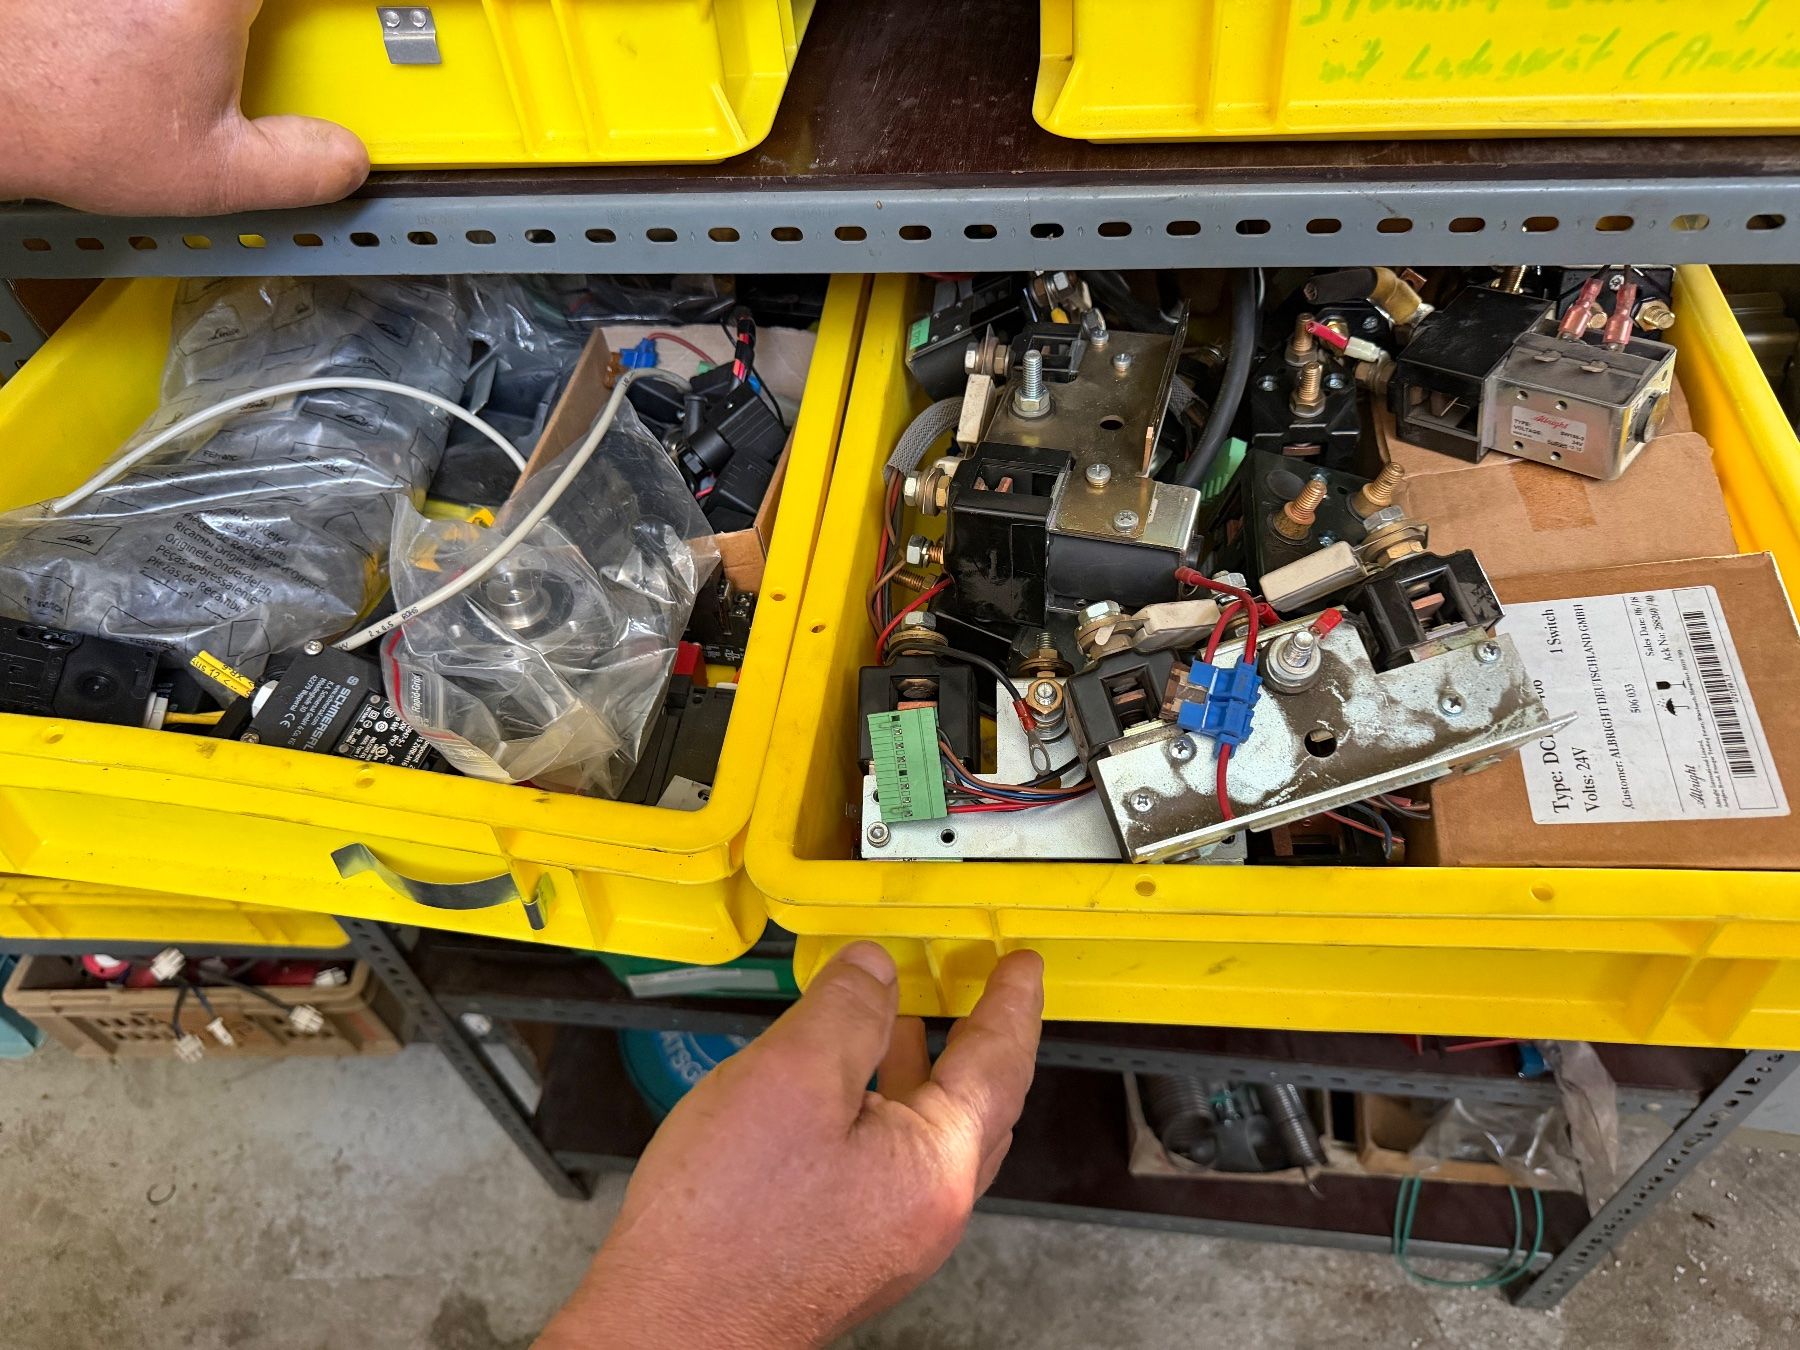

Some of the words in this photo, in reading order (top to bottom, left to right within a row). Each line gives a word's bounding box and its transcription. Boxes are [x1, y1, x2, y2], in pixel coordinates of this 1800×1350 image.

[1541, 608, 1562, 647] Switch
[1573, 603, 1591, 634] GMBH
[1643, 638, 1655, 657] Sales
[1581, 637, 1608, 707] DEUTSCHLAND
[302, 685, 351, 753] SCHMERSAL
[1601, 706, 1622, 759] ALBRIGHT
[1571, 746, 1592, 771] 24V
[1552, 769, 1571, 814] Type:
[1581, 774, 1601, 813] Volts:
[1615, 758, 1635, 810] Customer:
